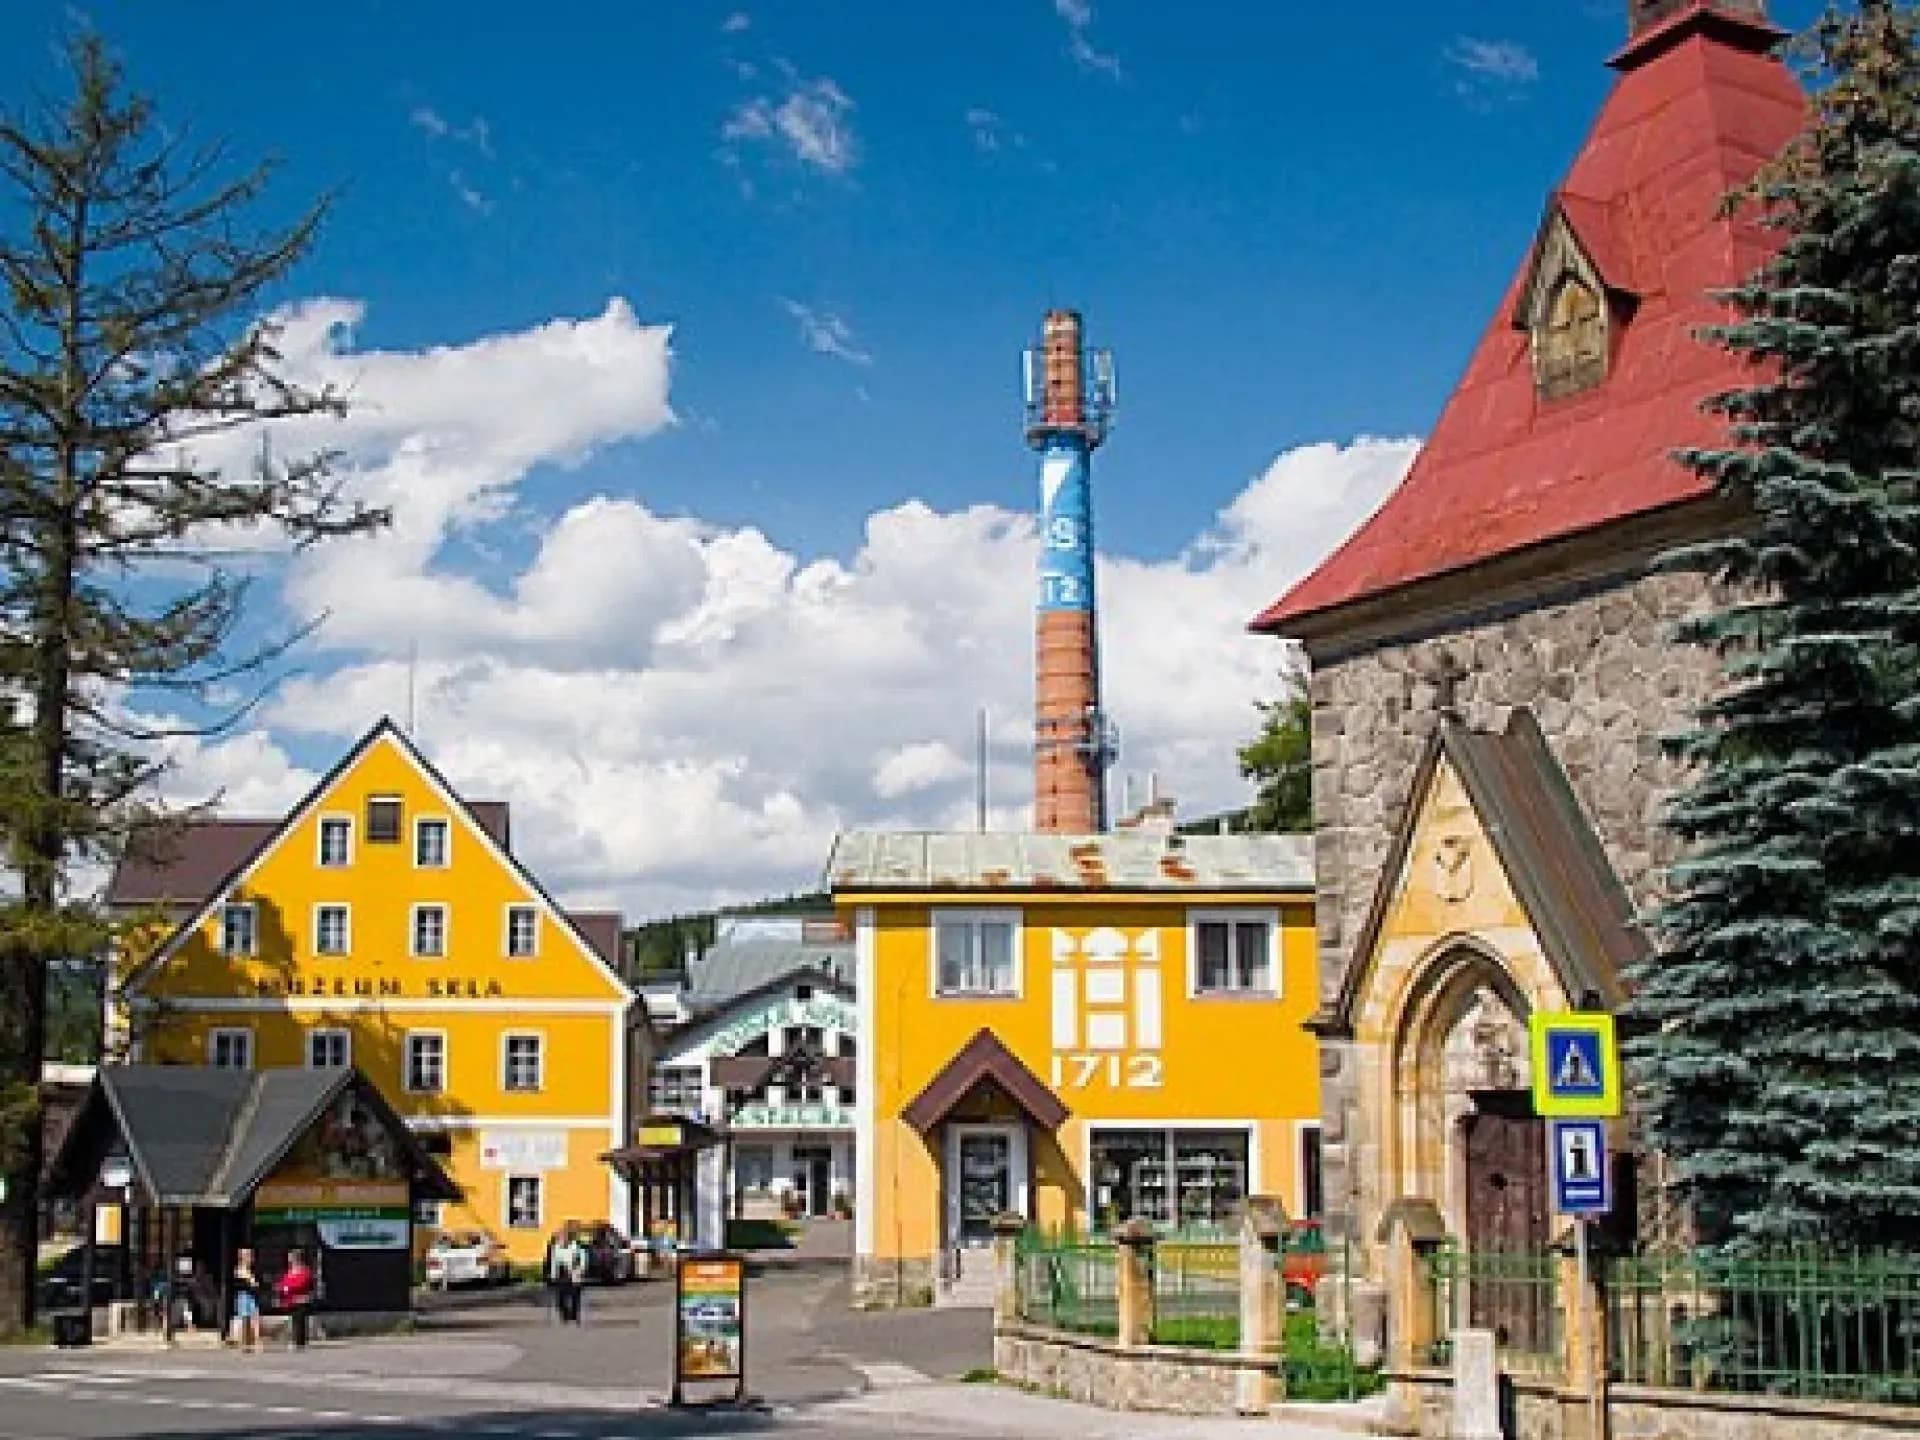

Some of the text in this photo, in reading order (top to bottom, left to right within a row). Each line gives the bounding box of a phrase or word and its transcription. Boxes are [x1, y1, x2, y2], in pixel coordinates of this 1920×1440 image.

[256, 976, 502, 998] MUZEUM SKLA
[1050, 1055, 1165, 1088] 1712
